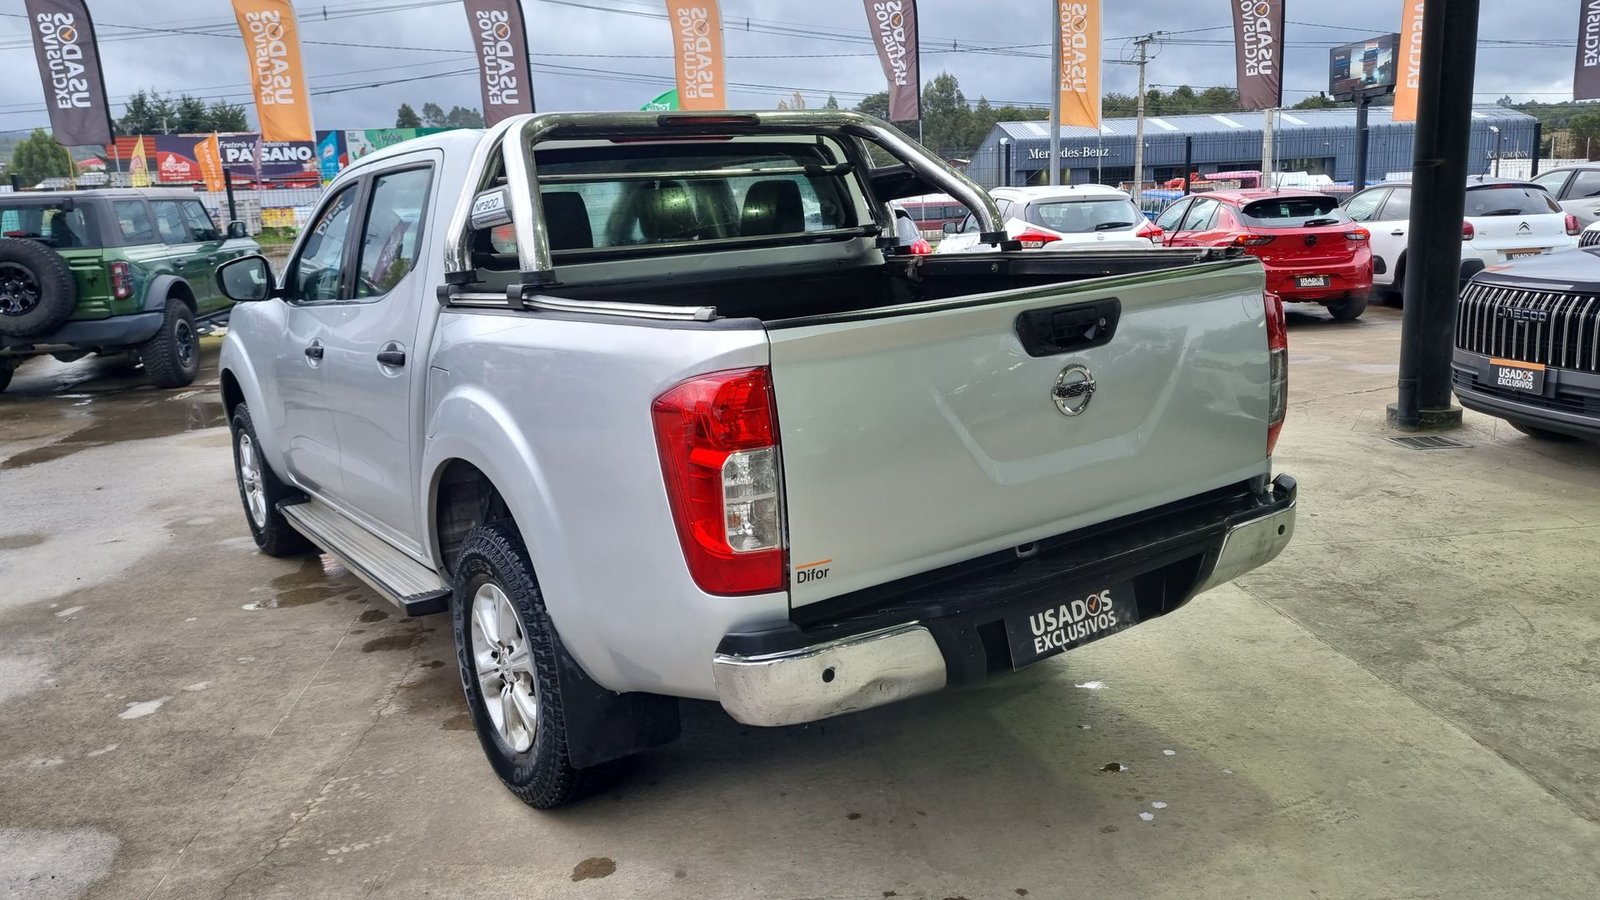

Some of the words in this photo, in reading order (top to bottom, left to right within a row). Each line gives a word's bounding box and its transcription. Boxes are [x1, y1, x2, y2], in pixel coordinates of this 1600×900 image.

[226, 147, 312, 162] PASANO
[1028, 147, 1109, 160] Merdes-Benz
[1499, 368, 1534, 381] USADOS
[1498, 378, 1533, 389] EXCLUSIVOS
[797, 568, 829, 584] Difor
[1029, 589, 1113, 636] USADOS
[1034, 610, 1117, 654] EXCLUSIVOS
